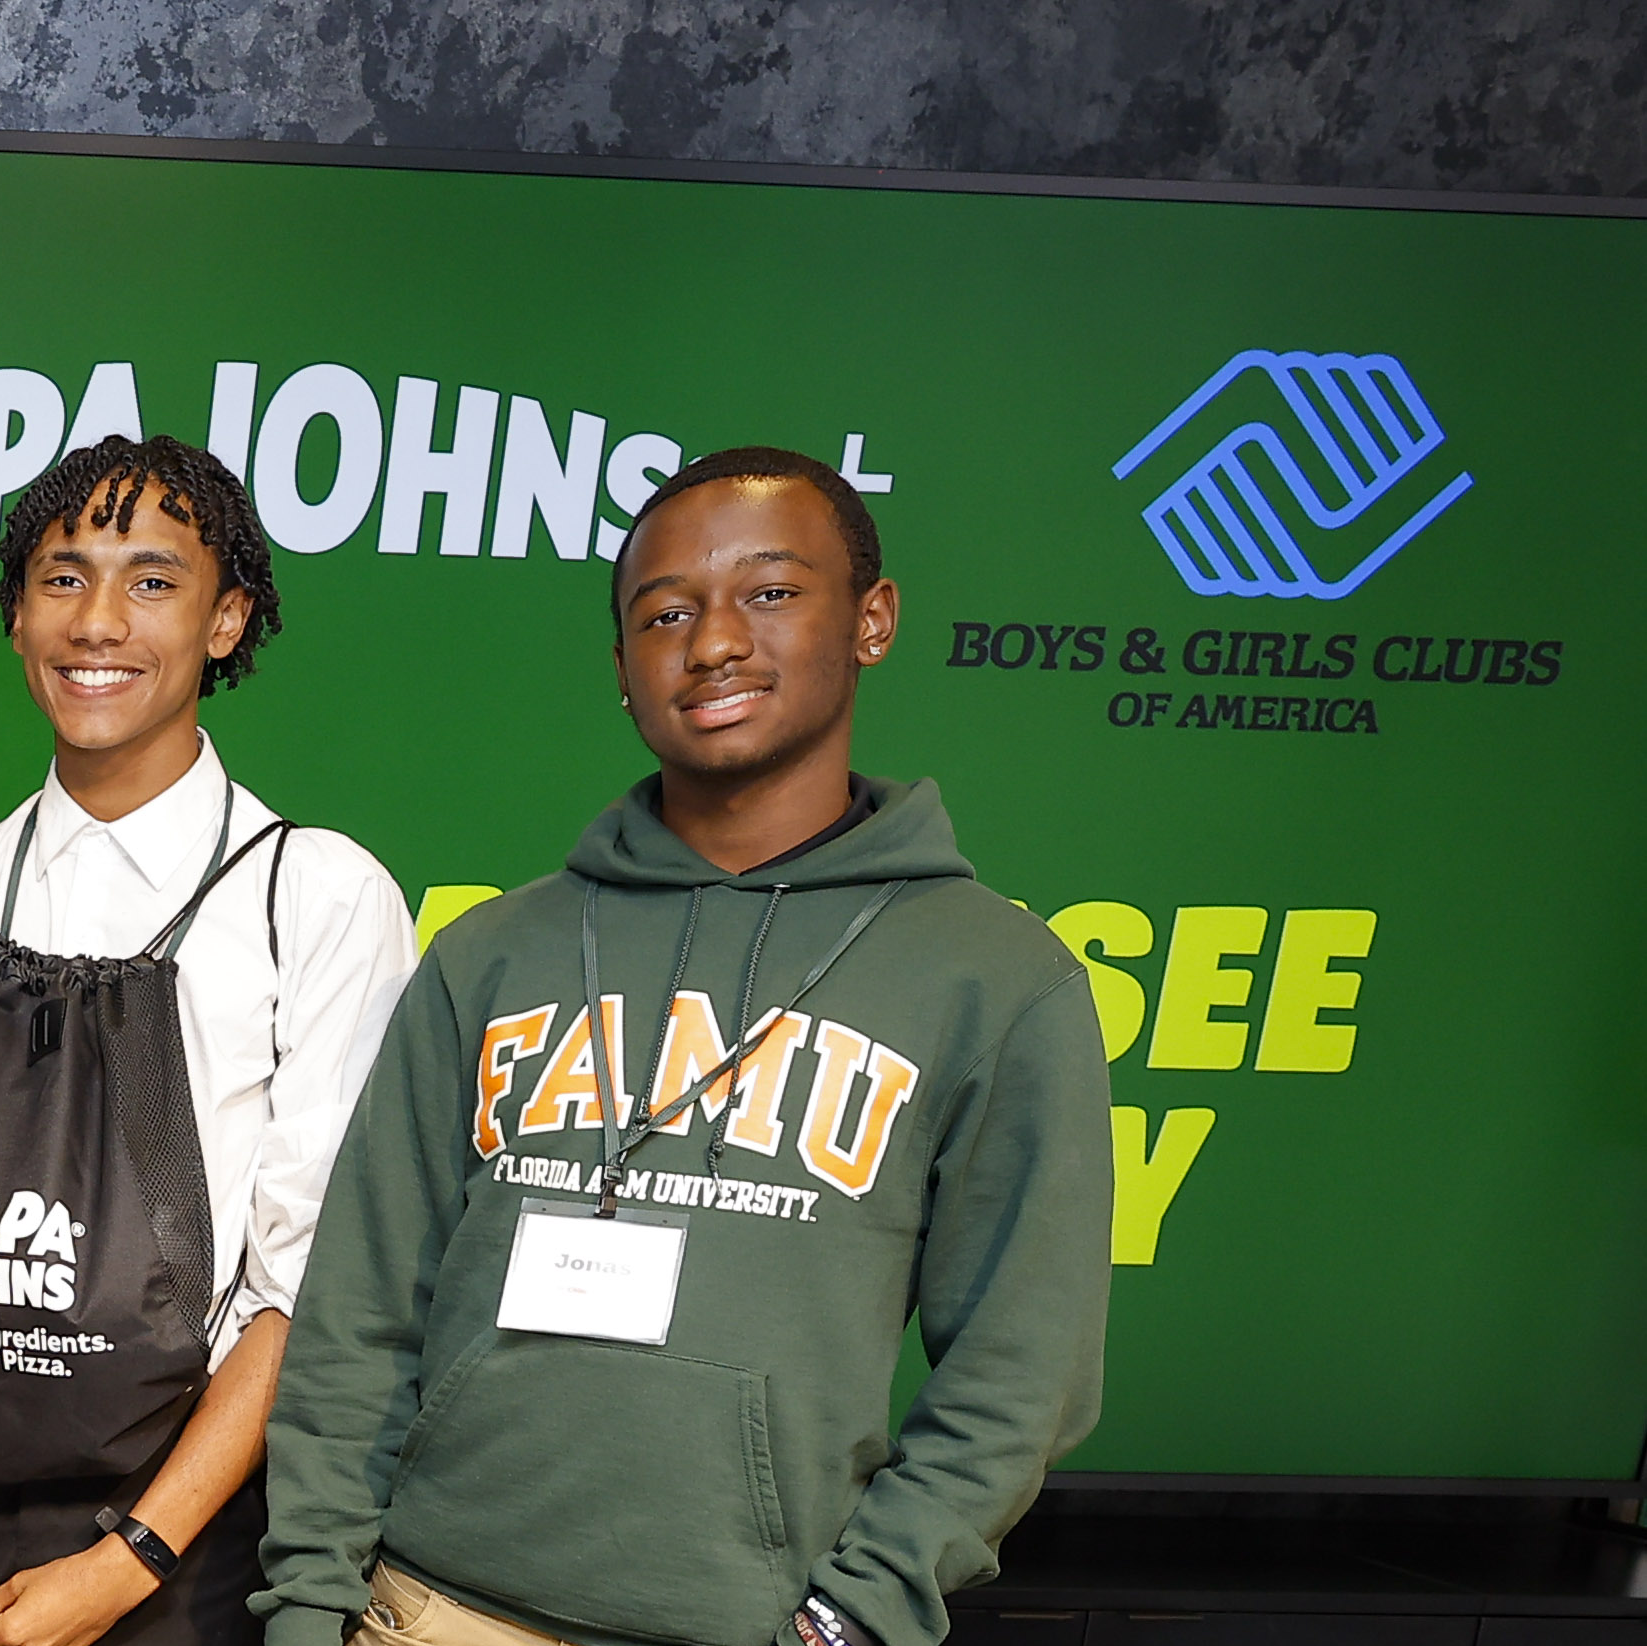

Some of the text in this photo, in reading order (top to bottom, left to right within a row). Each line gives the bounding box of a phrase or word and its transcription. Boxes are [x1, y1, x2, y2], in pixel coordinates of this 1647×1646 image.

[945, 621, 1564, 686] BOYS & GIRLS CLUBS
[1107, 691, 1380, 734] OF AMERICA
[472, 990, 921, 1199] FAMU
[493, 1154, 582, 1192] FLORIDA
[554, 1253, 632, 1276] Jonas
[2, 1349, 74, 1378] Pizza.
